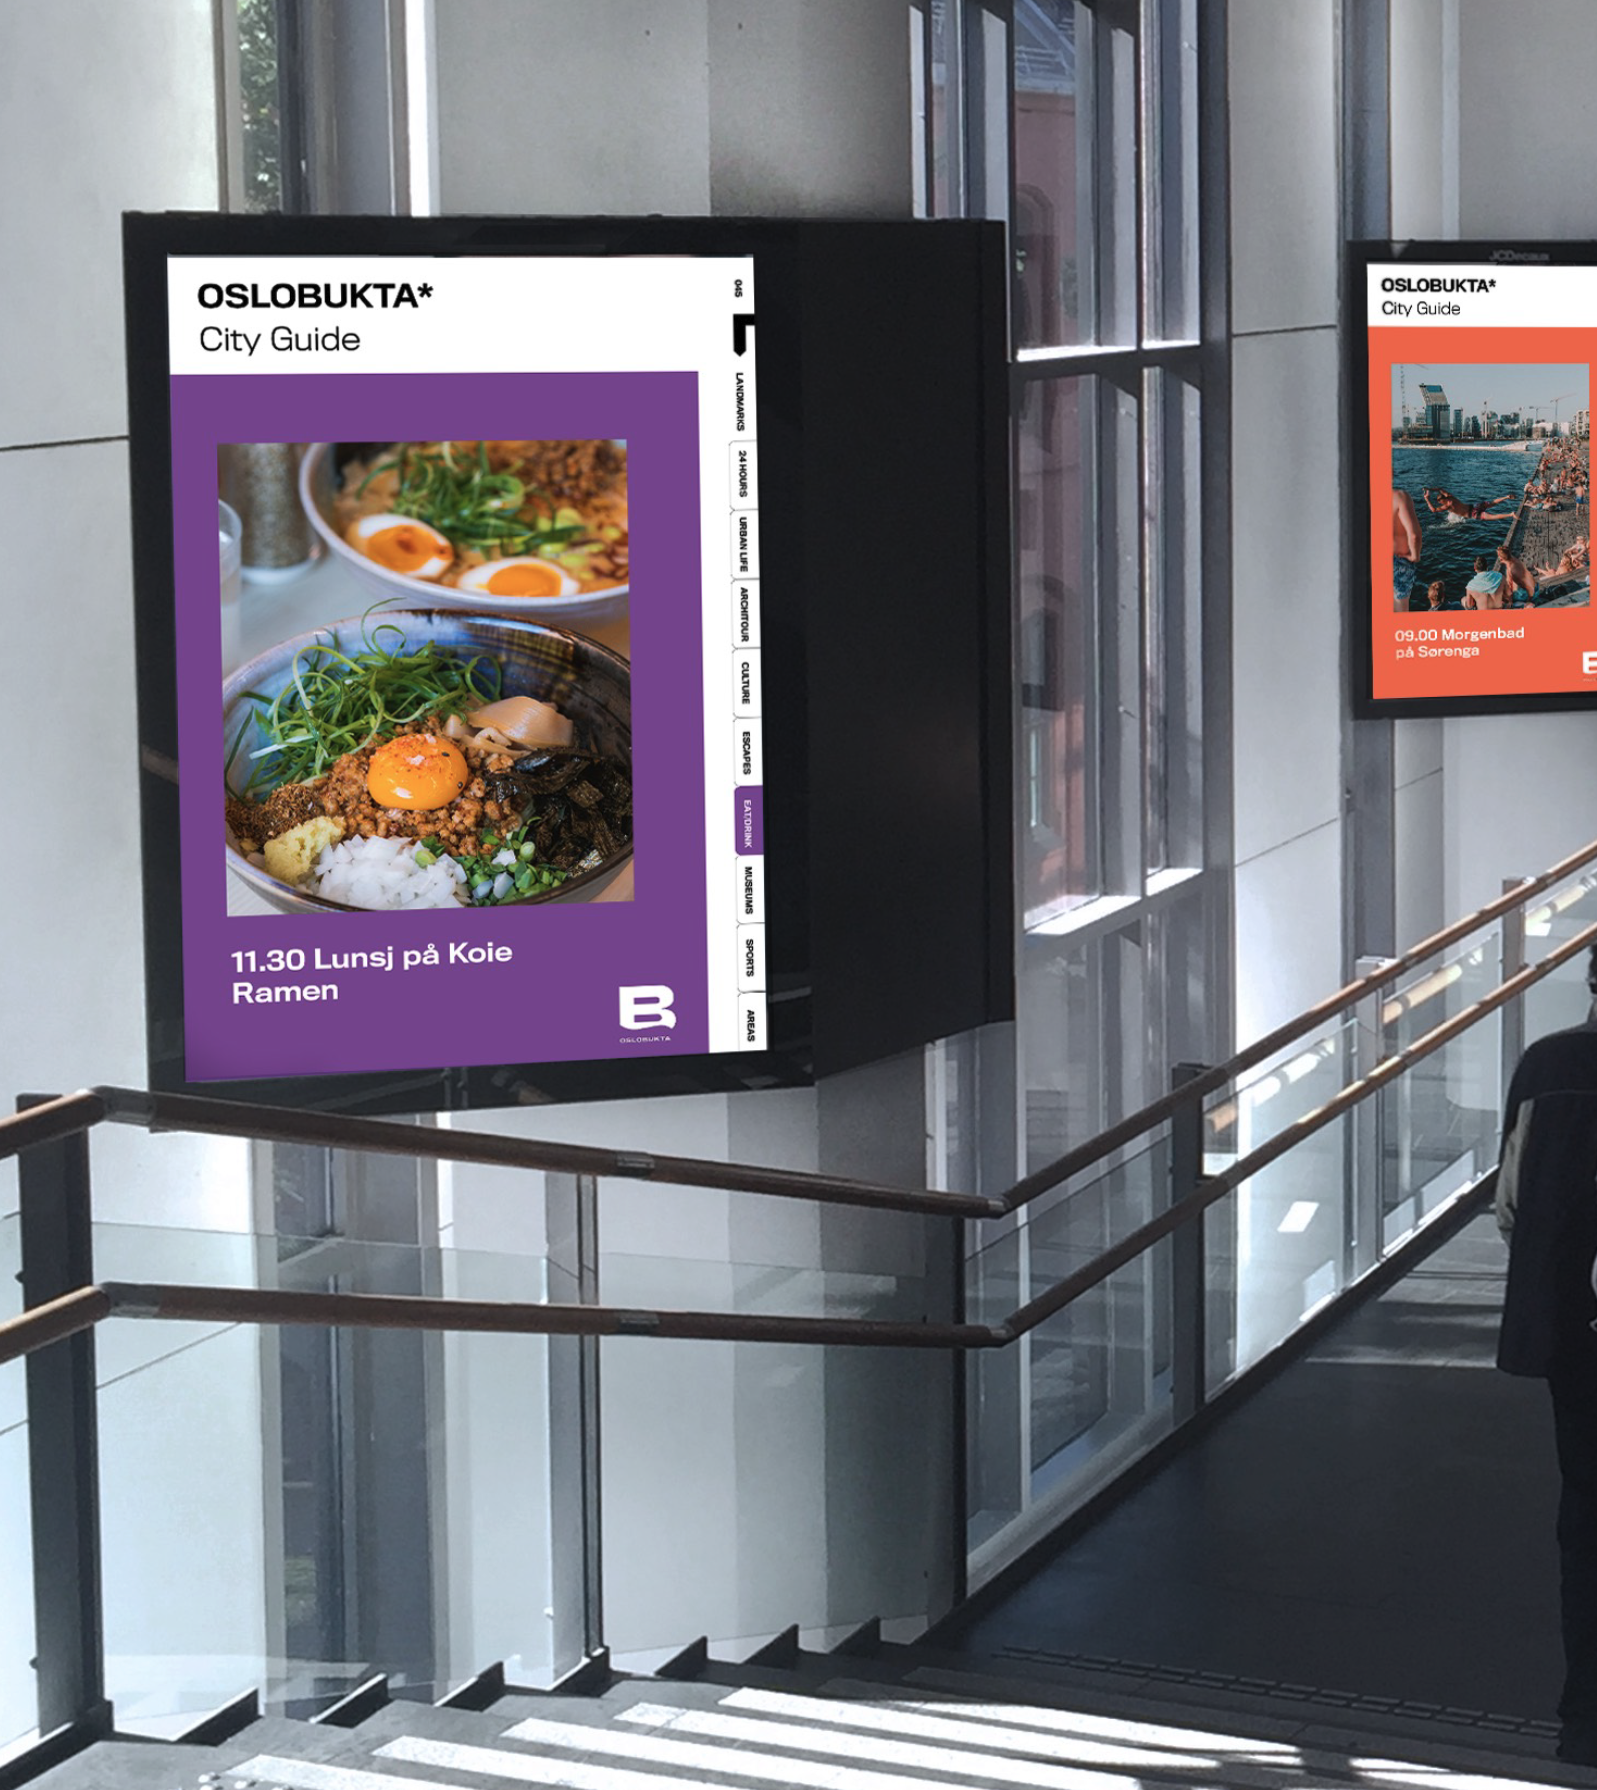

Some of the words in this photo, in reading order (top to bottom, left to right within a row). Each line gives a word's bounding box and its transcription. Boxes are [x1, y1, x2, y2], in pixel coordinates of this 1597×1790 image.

[1381, 300, 1413, 317] City
[1416, 300, 1461, 316] Guide
[199, 325, 262, 357] City
[270, 325, 361, 352] Guide
[735, 372, 745, 432] LANDMARKS
[739, 450, 747, 463] 24
[739, 464, 748, 498] HOURS
[739, 516, 748, 551] URBAN
[740, 552, 748, 572] LIFE
[740, 587, 750, 643] ARCHITOUR
[1394, 628, 1438, 642] 09.00
[1441, 626, 1525, 645] Morgenbad
[1396, 644, 1415, 659] på
[1417, 643, 1480, 660] Sørenga
[741, 661, 751, 705] CULTURE
[742, 731, 751, 776] ESCAPES
[745, 866, 753, 915] MUSEUMS
[231, 948, 306, 973] 11.30
[314, 945, 394, 972] Lunsj
[403, 942, 440, 971] på
[449, 941, 513, 964] Koie
[745, 938, 755, 978] SPORTS
[232, 981, 339, 1005] Ramen
[746, 1009, 756, 1042] AREAS
